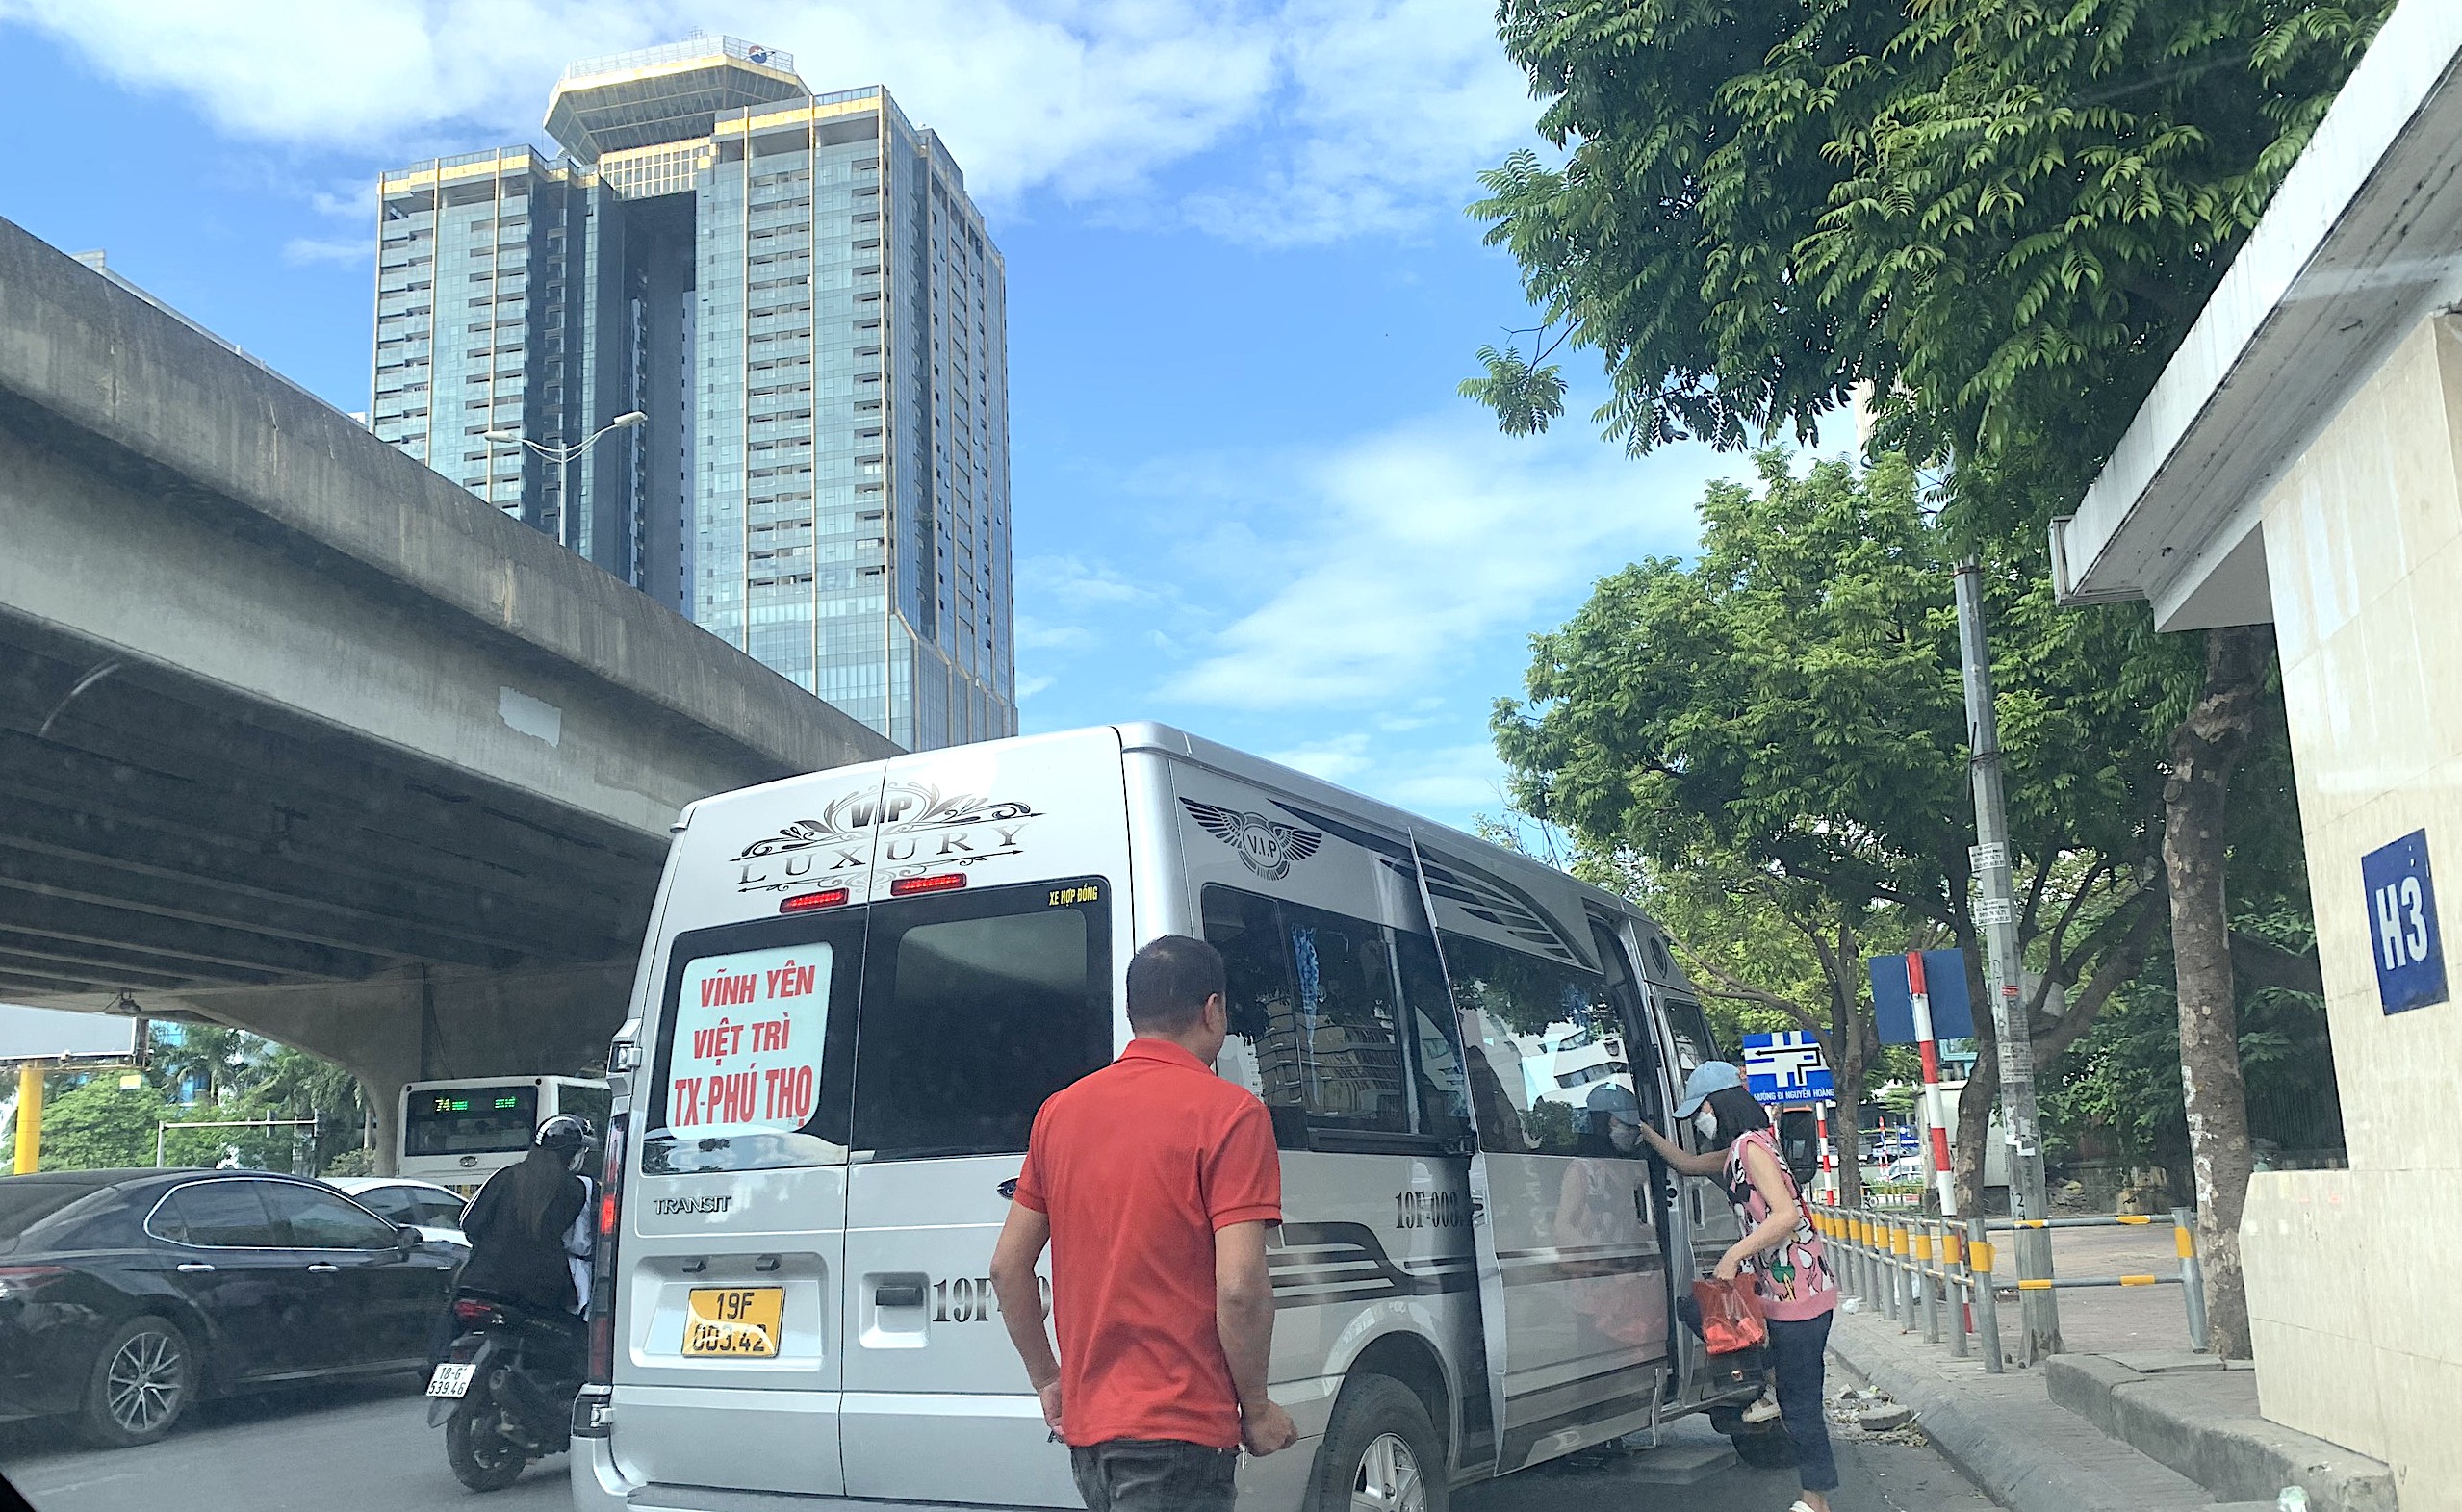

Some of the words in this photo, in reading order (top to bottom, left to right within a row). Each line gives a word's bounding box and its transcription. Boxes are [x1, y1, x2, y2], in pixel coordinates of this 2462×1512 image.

[850, 796, 913, 828] VIP
[736, 823, 1030, 885] LUXURY
[1049, 891, 1060, 906] XE
[1061, 888, 1076, 907] HỢP
[2375, 876, 2429, 971] H3
[701, 968, 757, 1008] VĨNH
[766, 960, 816, 999] YÊN
[693, 1017, 744, 1066] VIỆT
[751, 1012, 790, 1053] TRÌ
[675, 1063, 757, 1127] TX-PHÚ
[765, 1065, 813, 1127] THỌ
[1813, 1087, 1835, 1097] HOÀNG
[653, 1196, 732, 1215] TRANSIT
[716, 1292, 755, 1320] 19F
[428, 1380, 467, 1395] 539.46
[439, 1367, 467, 1380] 18-G
